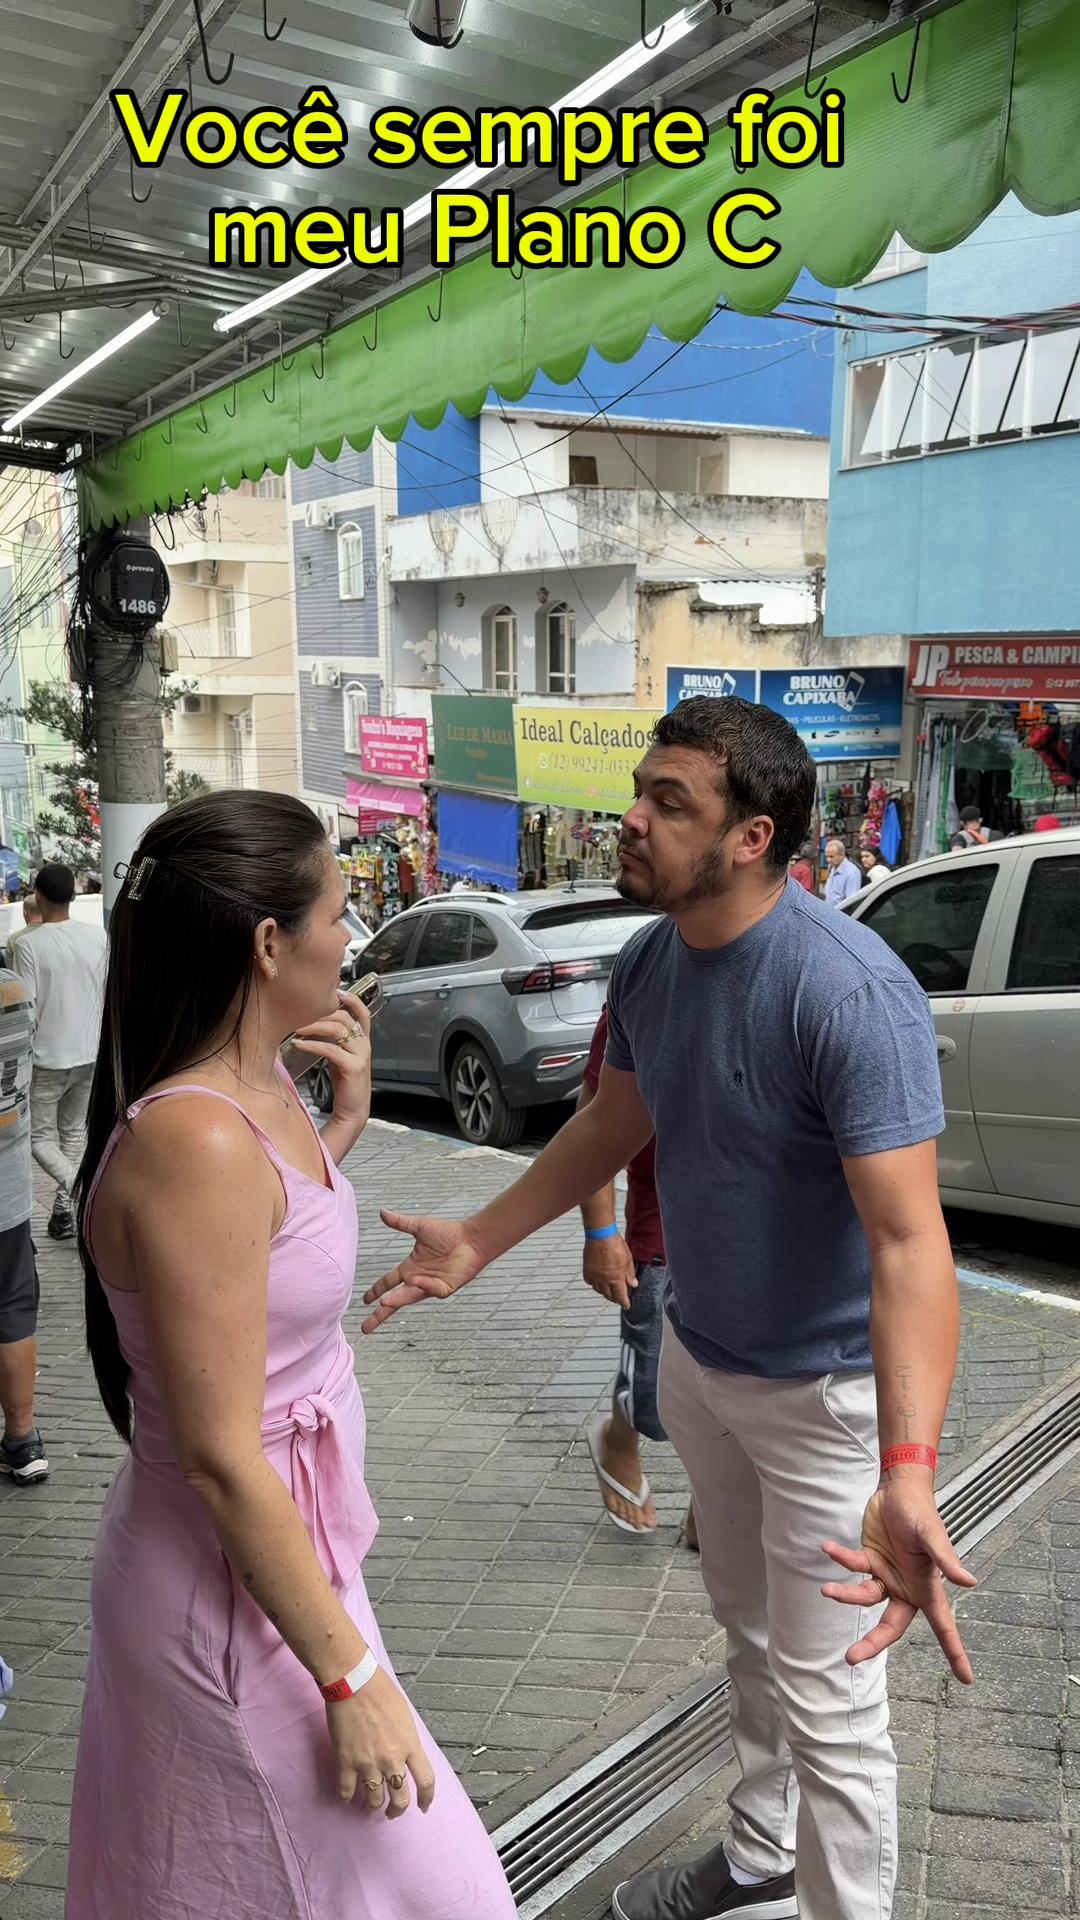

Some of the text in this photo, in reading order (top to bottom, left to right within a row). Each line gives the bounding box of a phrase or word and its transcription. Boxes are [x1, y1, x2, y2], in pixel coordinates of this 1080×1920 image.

[119, 599, 156, 614] 1486
[954, 645, 1080, 665] PESCA & CAMPI
[912, 644, 950, 687] JP
[683, 674, 721, 689] BRUNO
[789, 675, 845, 690] BRUNO
[783, 691, 856, 706] CAPIXABA
[447, 724, 514, 745] LUZ DE MARIA
[520, 717, 653, 754] Ideal Calçados
